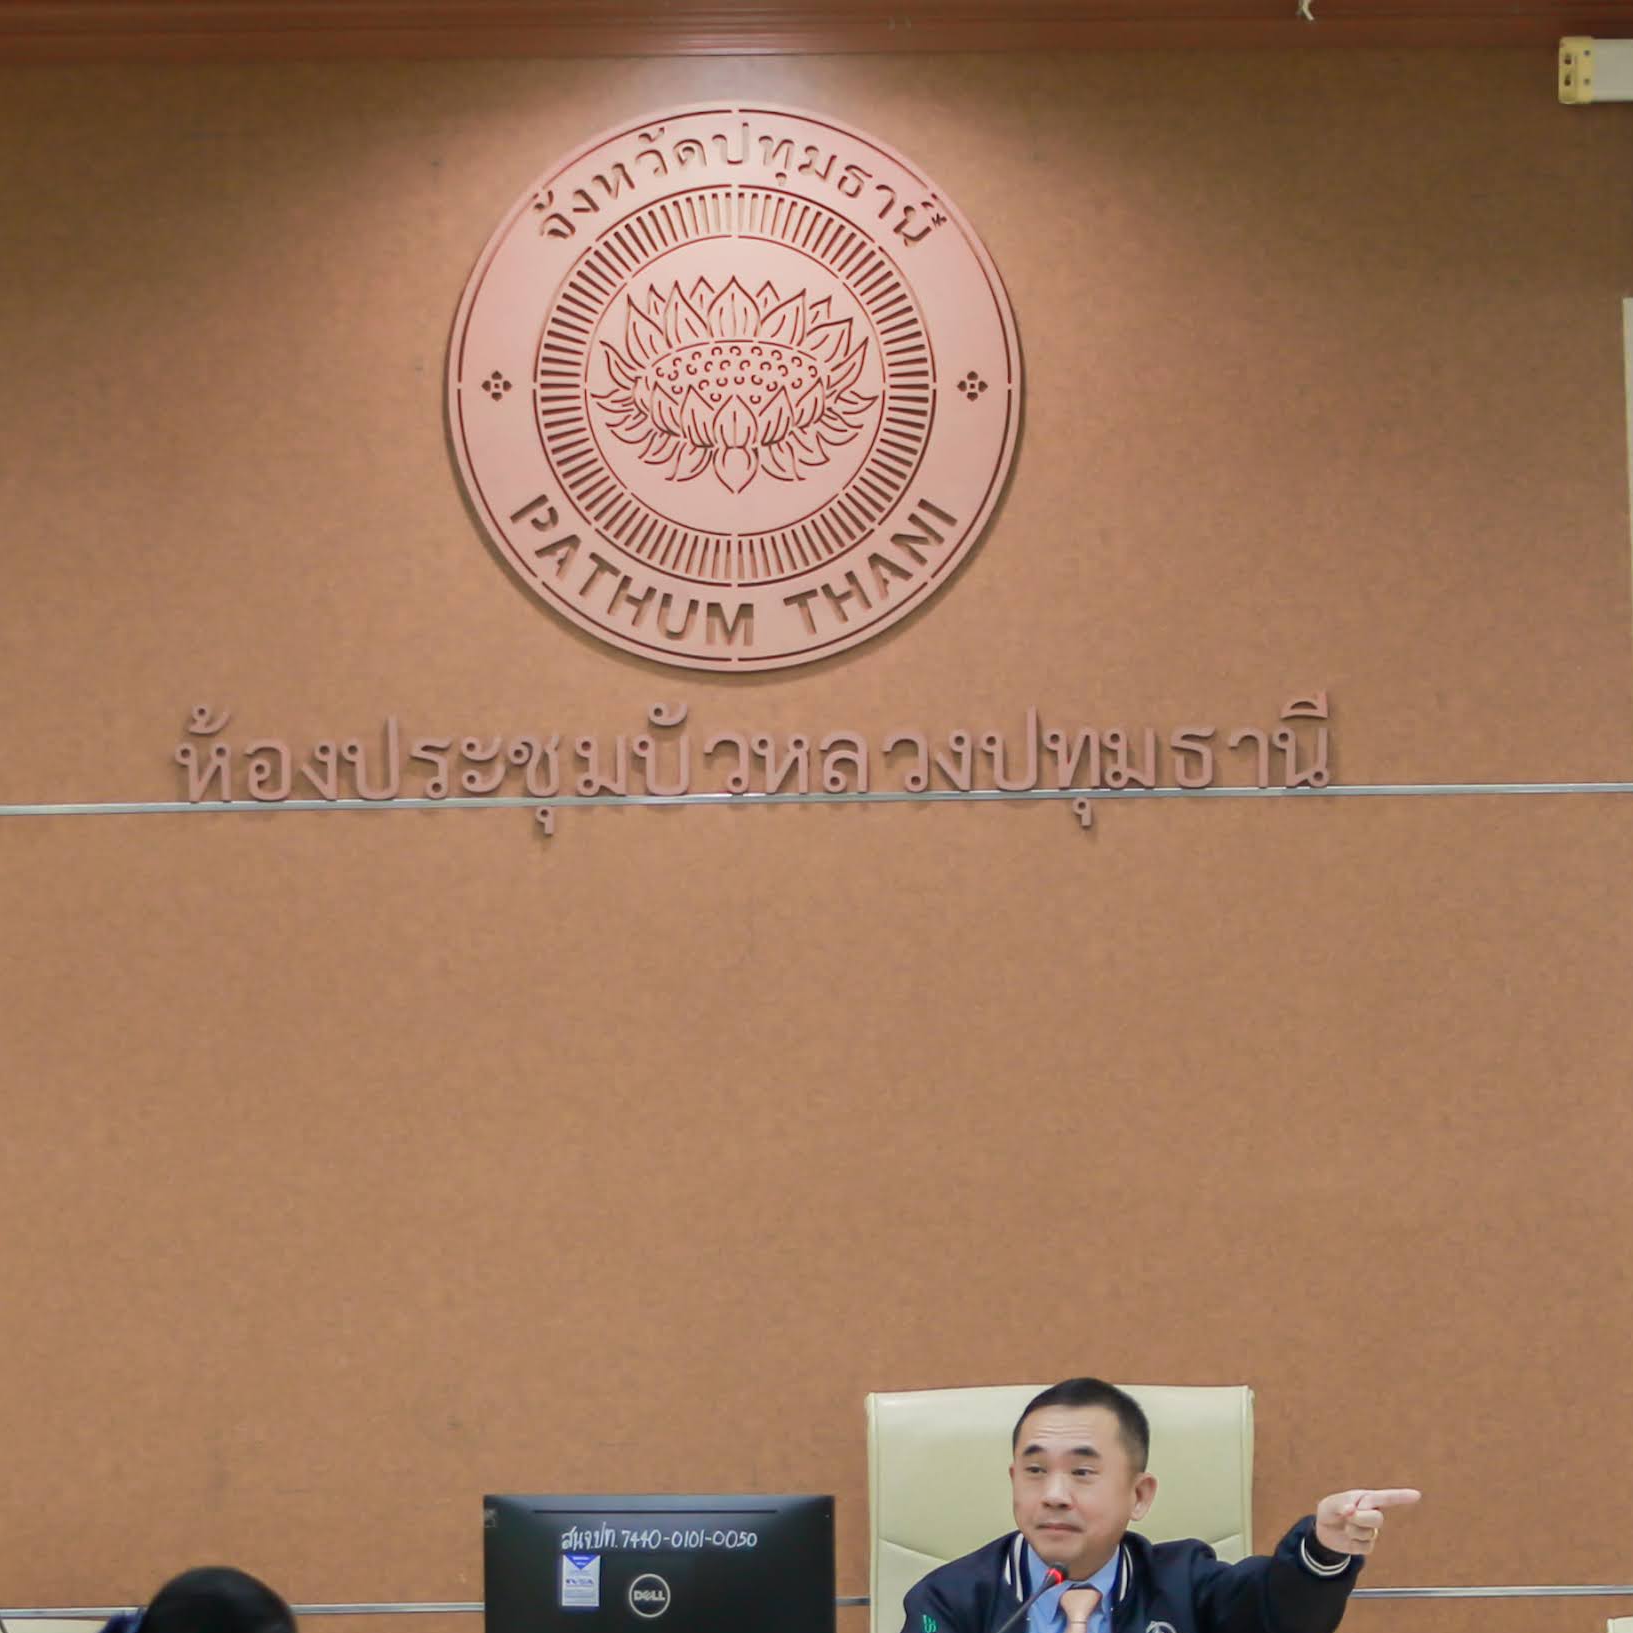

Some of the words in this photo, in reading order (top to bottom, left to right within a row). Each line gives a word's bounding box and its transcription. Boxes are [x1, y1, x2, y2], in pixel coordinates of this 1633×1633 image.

[535, 120, 950, 247] จังหวัดปทุมธานี
[510, 490, 757, 648] PATHUM
[785, 496, 960, 640] THANI
[173, 690, 1332, 837] ห้องประชุมบัวหลวงปทุมธานี
[633, 1589, 666, 1601] DELL
